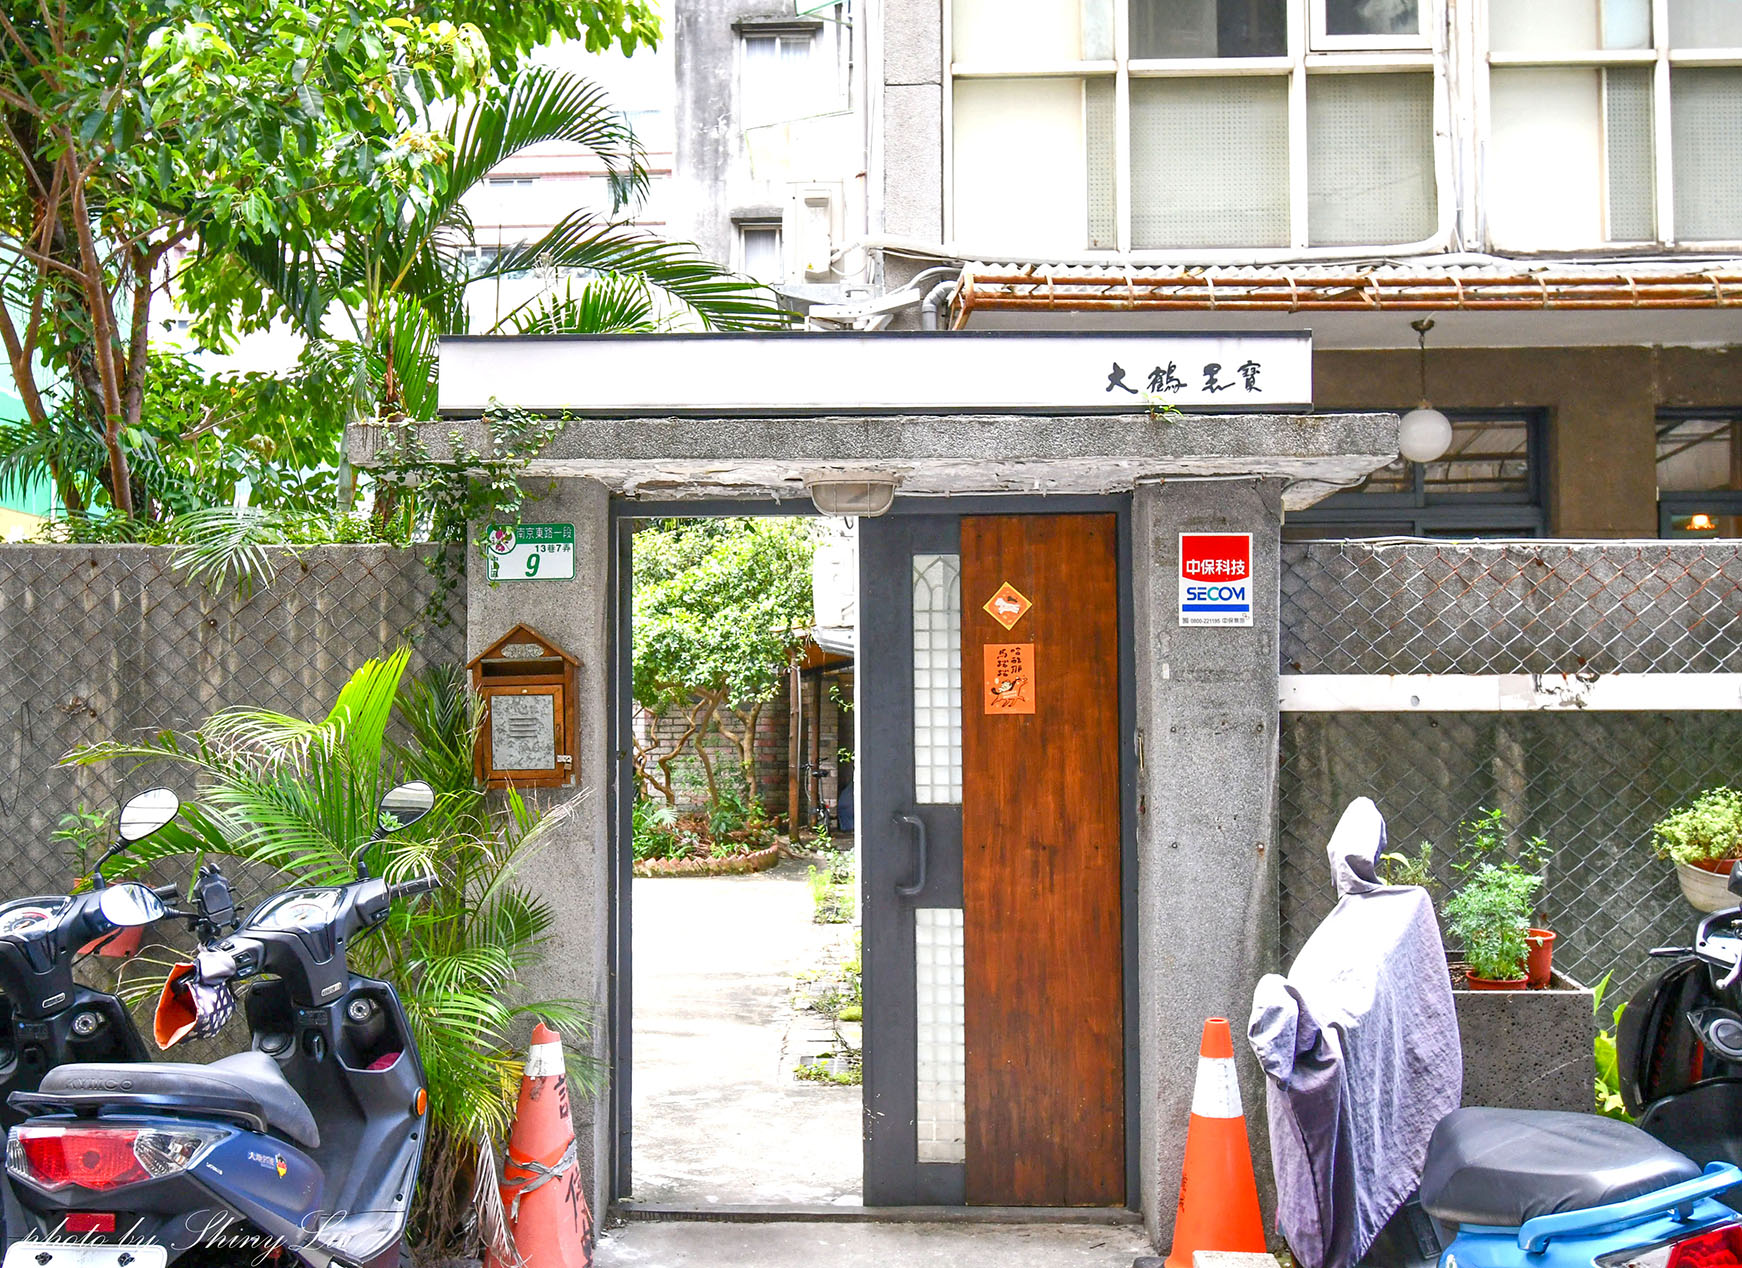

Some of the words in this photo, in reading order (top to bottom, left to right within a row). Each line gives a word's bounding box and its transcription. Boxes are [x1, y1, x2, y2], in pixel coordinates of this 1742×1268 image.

[517, 526, 572, 539] 南京東路一段
[535, 544, 571, 553] 13巷7弄
[525, 553, 541, 577] 9
[1186, 558, 1245, 575] 中保科技
[1186, 586, 1245, 601] SECOM
